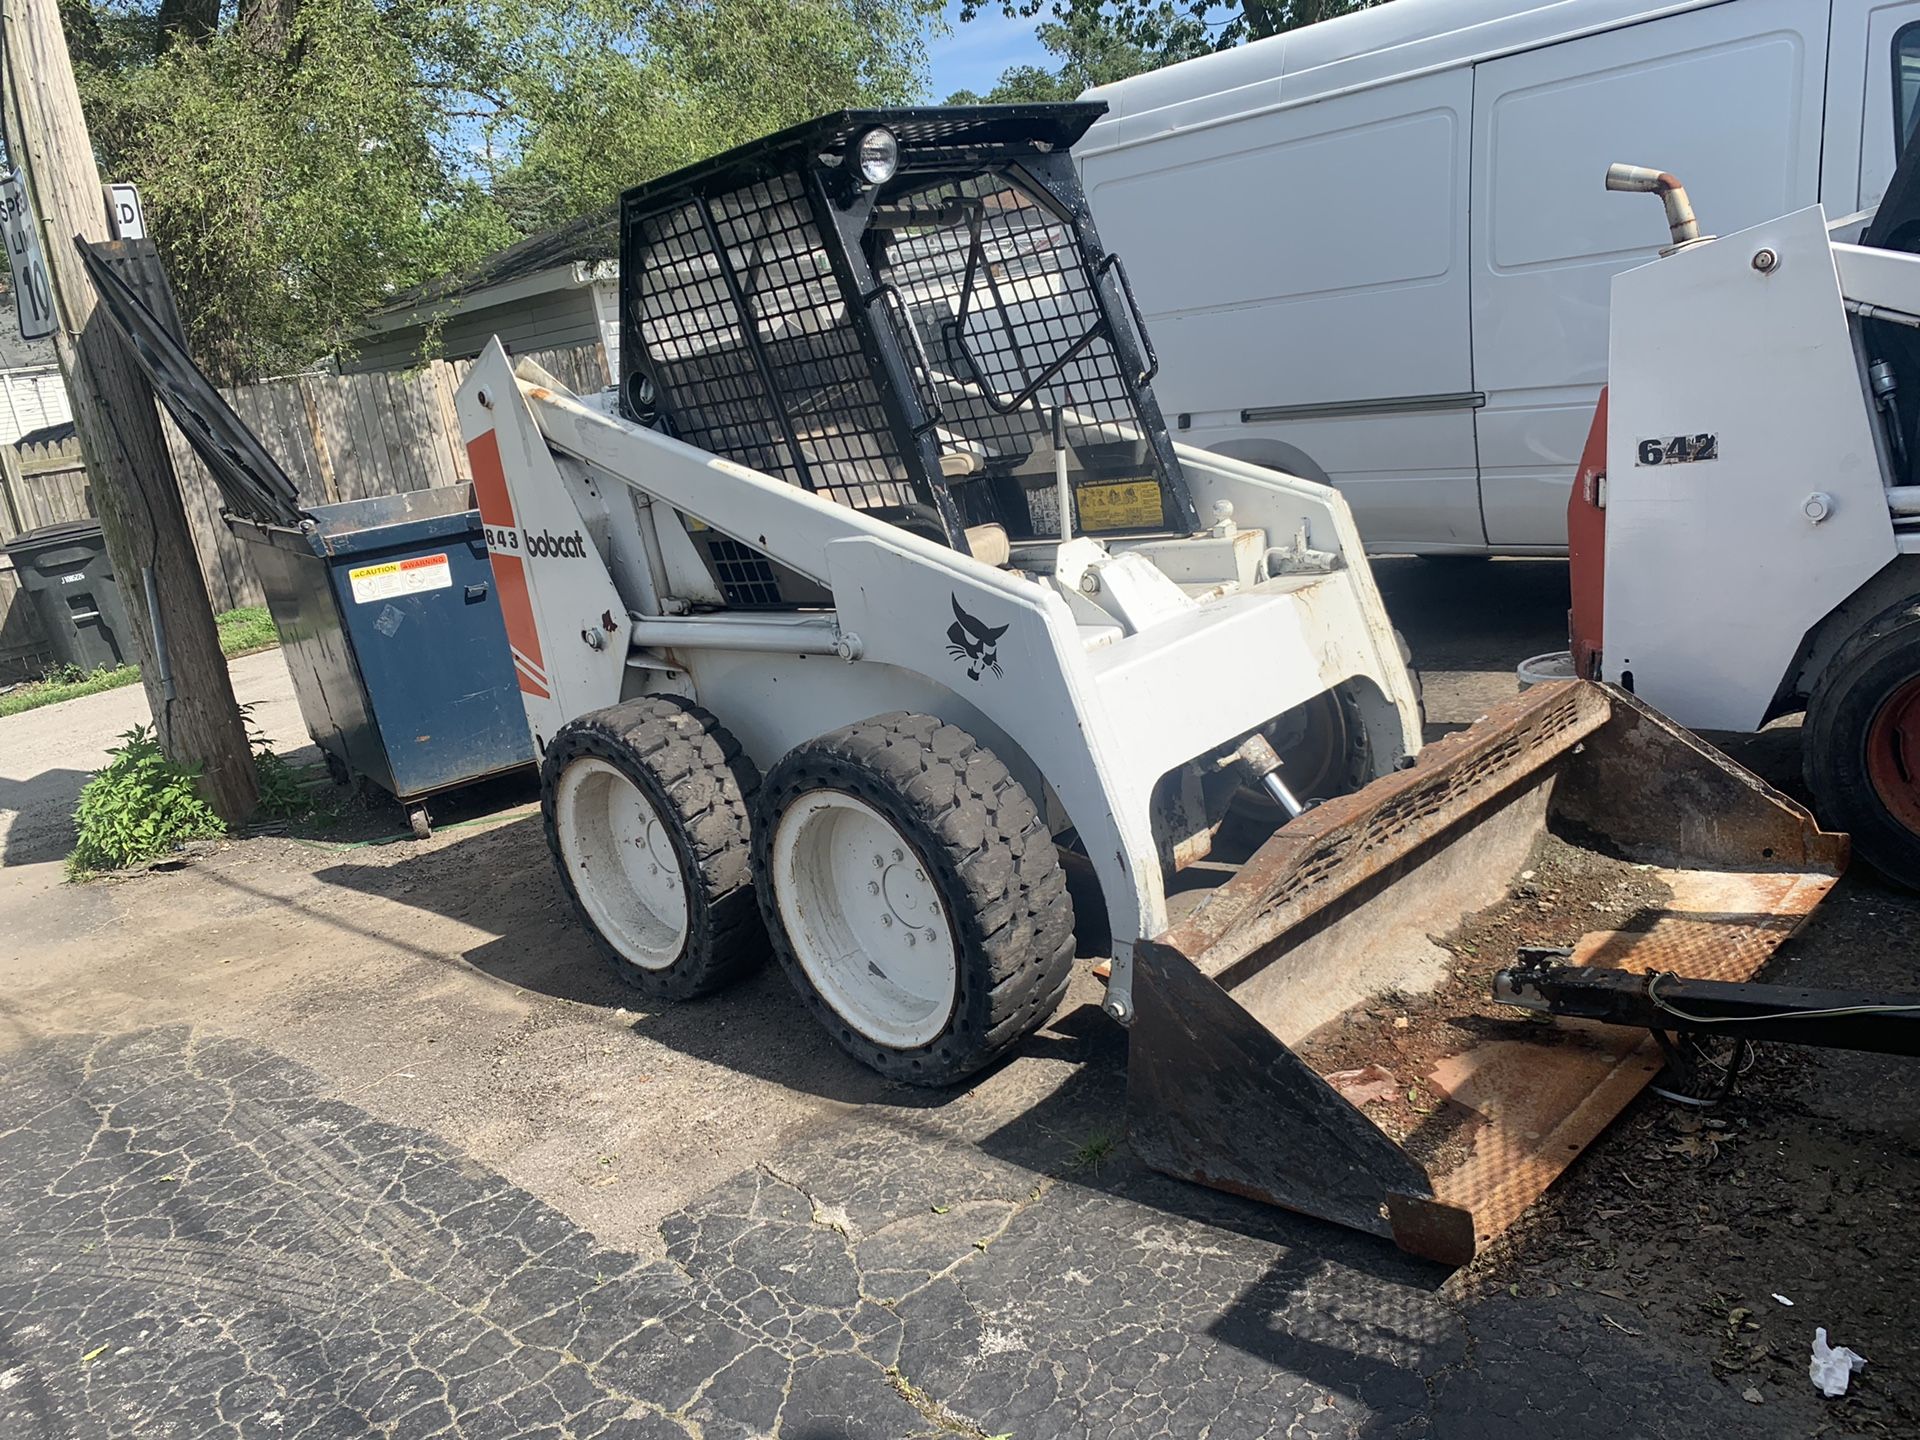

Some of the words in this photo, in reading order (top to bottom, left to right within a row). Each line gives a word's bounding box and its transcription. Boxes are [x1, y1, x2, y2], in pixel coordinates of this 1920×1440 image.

[22, 260, 49, 321] 10
[1638, 433, 1717, 465] 642
[485, 529, 519, 549] 843
[523, 529, 586, 558] bobcat
[359, 565, 397, 577] CAUTION
[407, 556, 444, 569] WARNING
